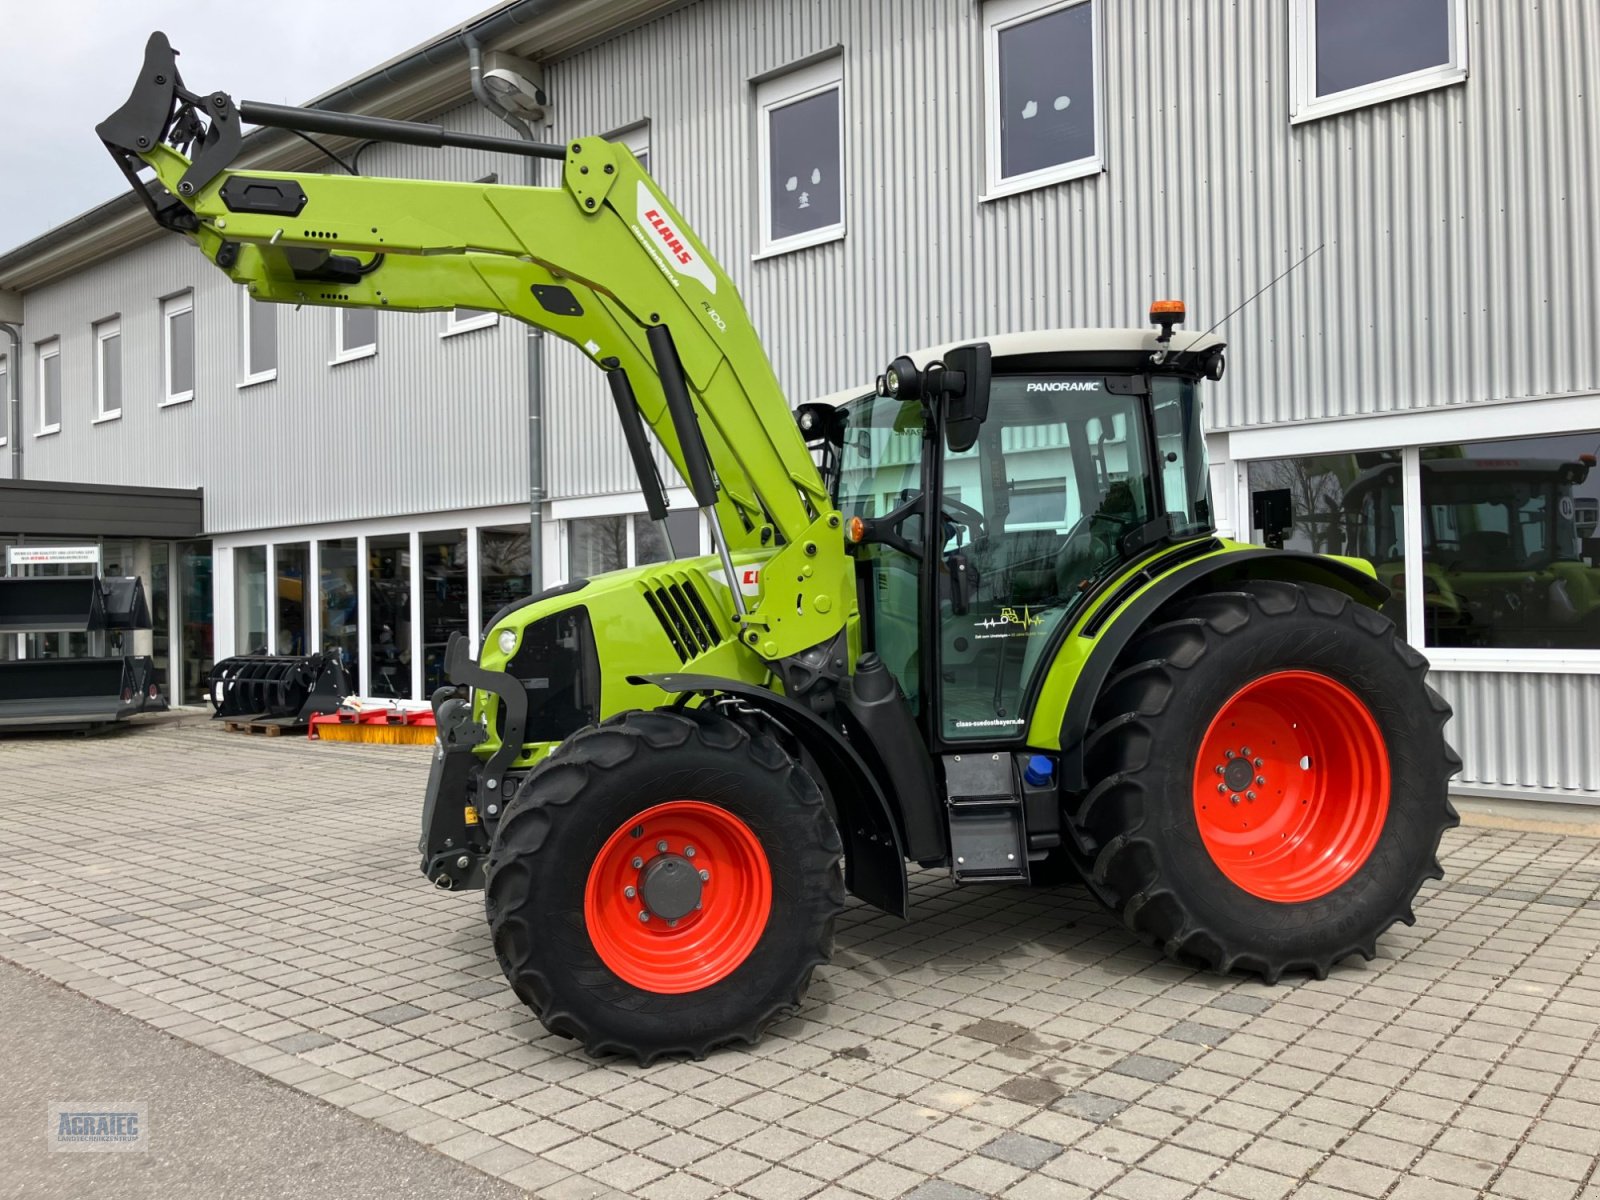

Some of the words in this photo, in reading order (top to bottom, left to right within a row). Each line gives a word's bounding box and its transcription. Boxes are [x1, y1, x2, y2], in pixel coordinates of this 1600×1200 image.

[645, 210, 692, 264] CLAAS
[1026, 382, 1100, 392] PANORAMIC
[956, 718, 1025, 727] claas-suedostbayern.de
